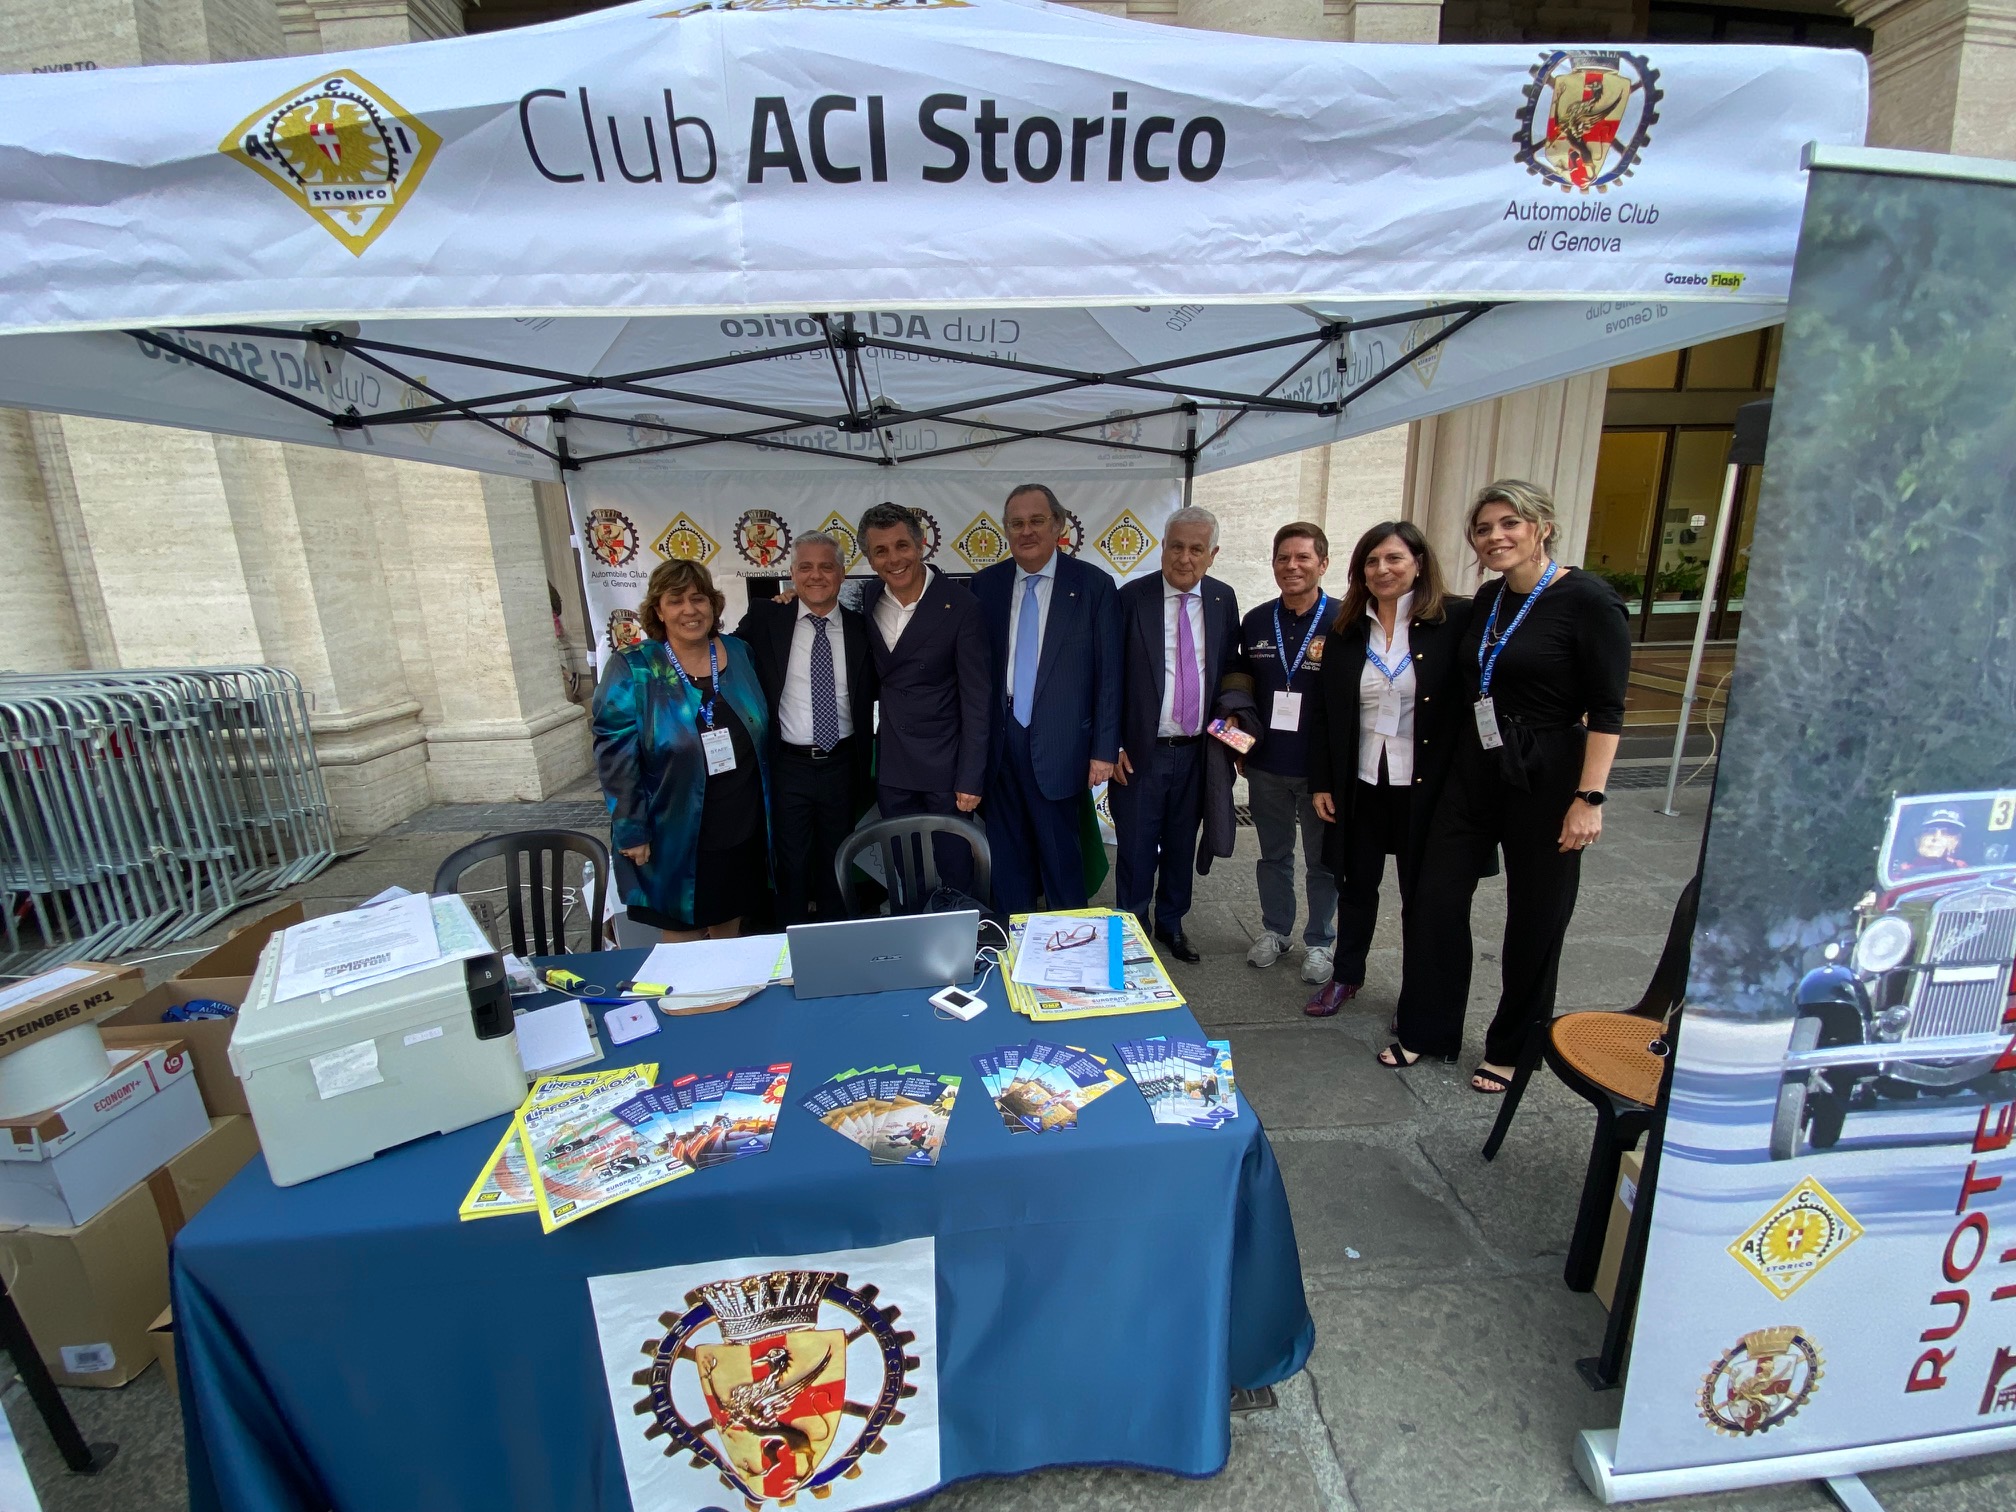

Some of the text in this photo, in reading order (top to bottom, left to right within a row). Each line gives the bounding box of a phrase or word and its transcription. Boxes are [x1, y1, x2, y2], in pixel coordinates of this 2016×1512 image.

[518, 86, 1226, 184] Club ACI Storico
[312, 187, 388, 202] STORICO
[1503, 199, 1660, 226] Automobile Club
[1527, 230, 1622, 253] di Genova
[1664, 272, 1742, 288] Gazebo Flash
[591, 570, 648, 579] Automobile Club
[736, 569, 779, 578] Automobile
[610, 579, 637, 588] Genova
[0, 1003, 81, 1047] STEINBEIS
[166, 1056, 180, 1070] IQ
[94, 1080, 142, 1113] ECONOMY+
[1766, 1261, 1813, 1272] STORICO
